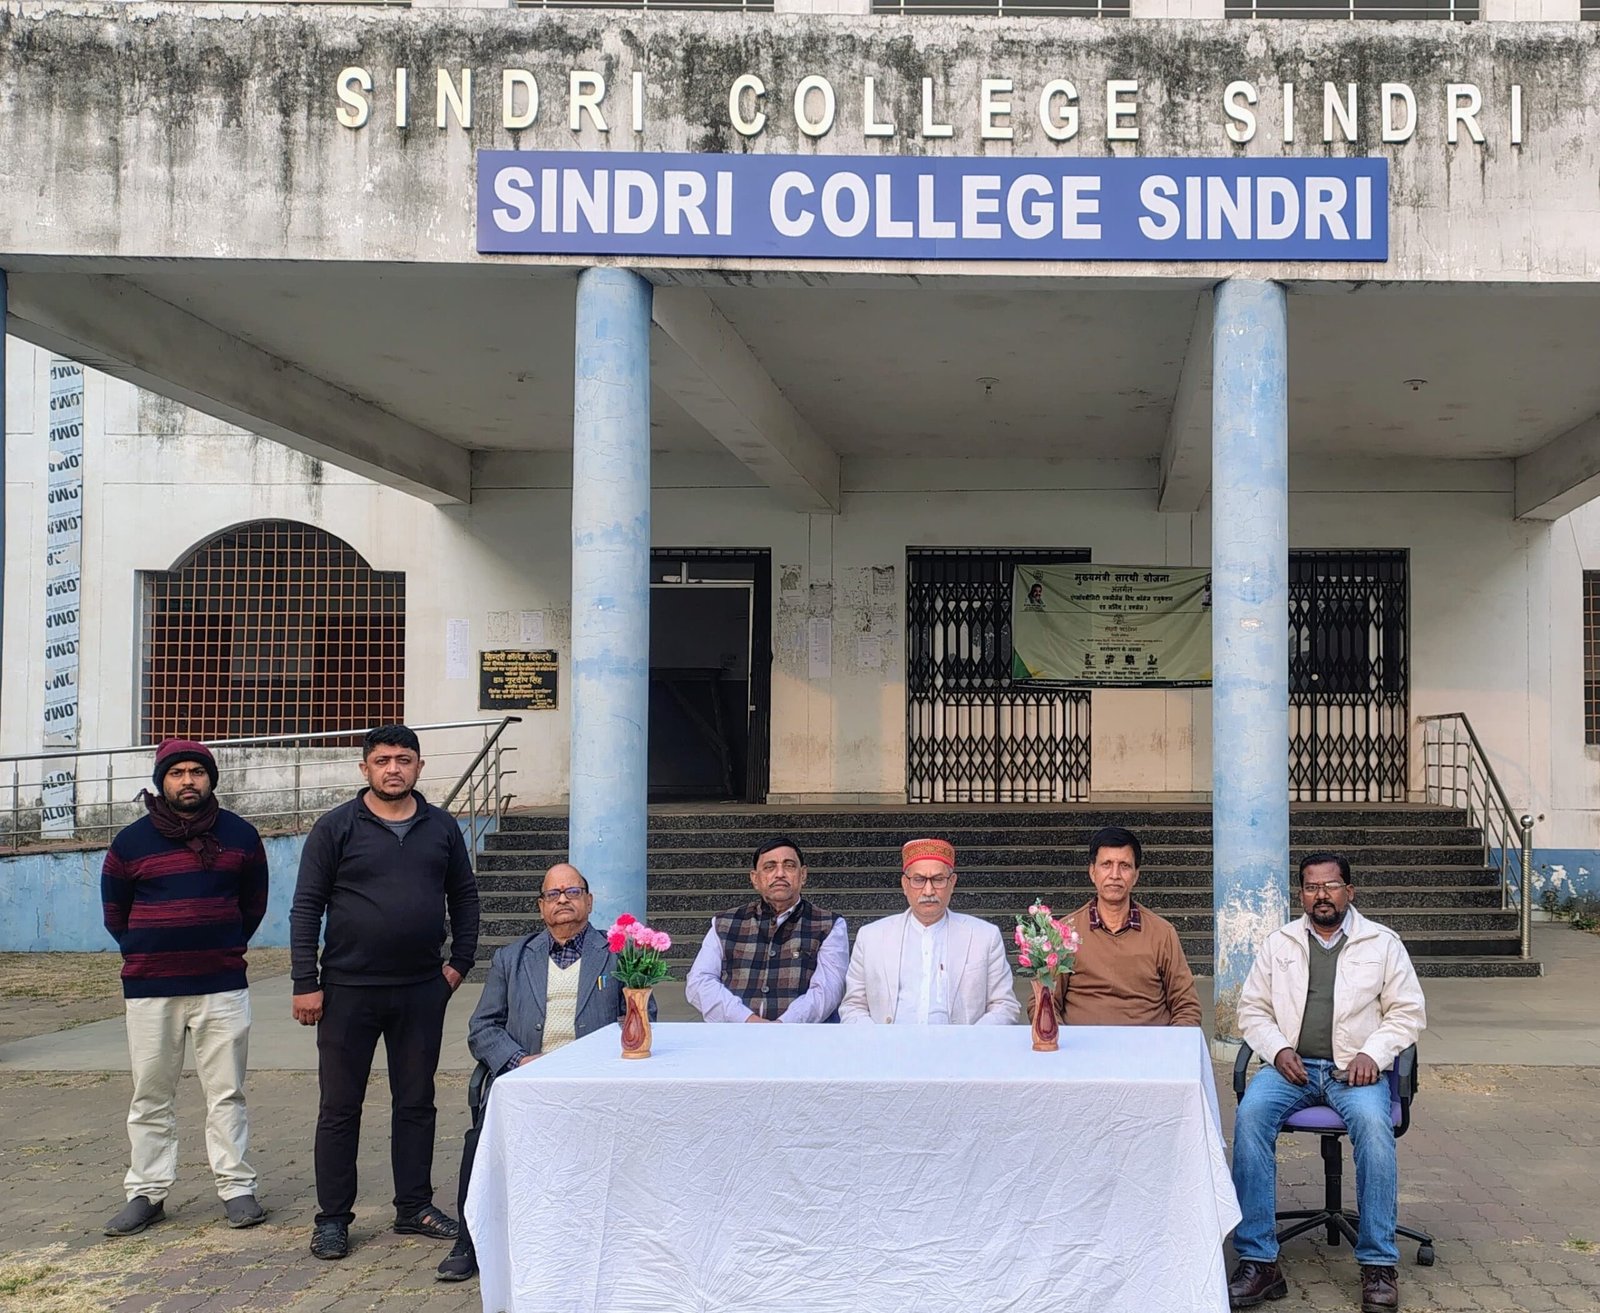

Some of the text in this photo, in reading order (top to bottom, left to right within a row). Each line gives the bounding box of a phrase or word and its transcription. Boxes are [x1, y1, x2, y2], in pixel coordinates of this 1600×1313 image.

[336, 66, 1523, 145] SINDRI COLLEGE SINDRI
[492, 167, 1373, 241] SINDRI COLLEGE SINDRI
[1074, 571, 1110, 585] मुख्यमंत्री
[1143, 572, 1170, 583] योजना
